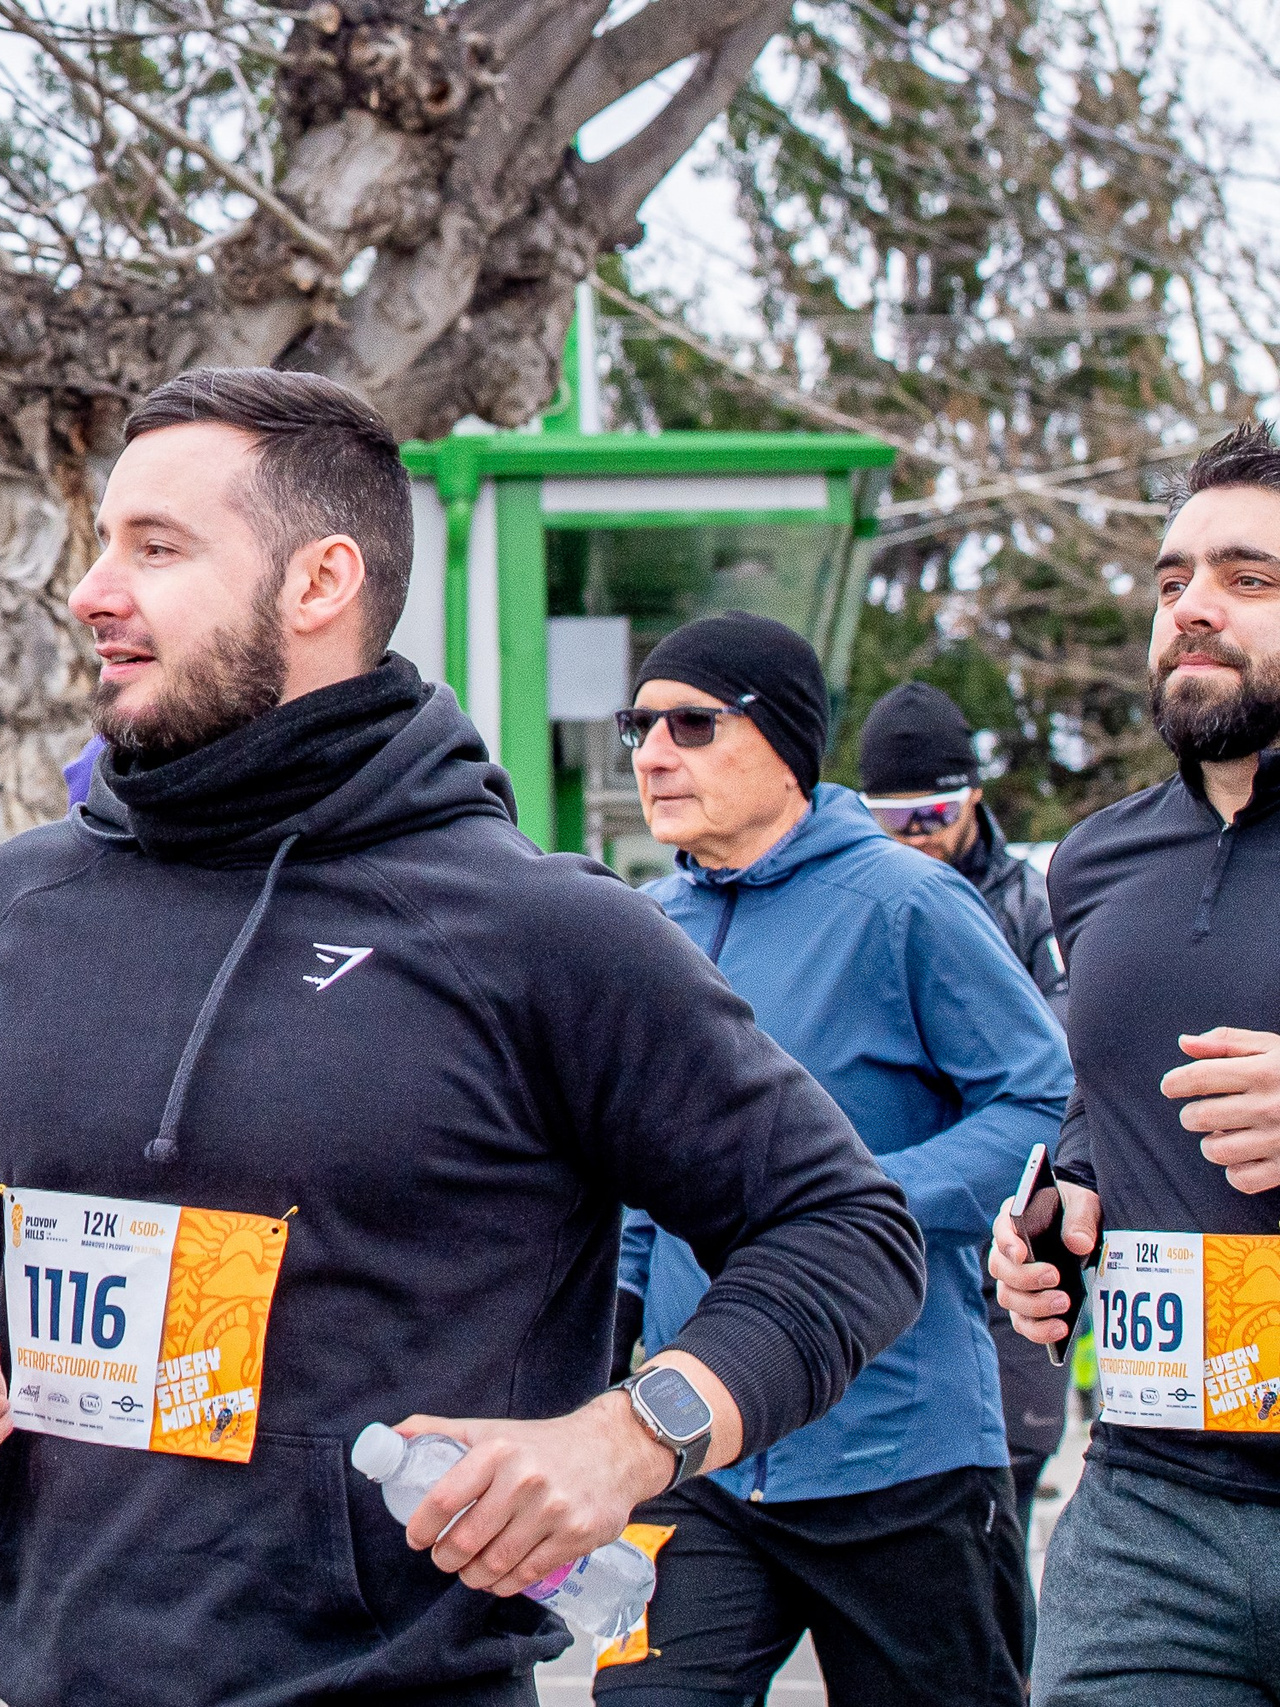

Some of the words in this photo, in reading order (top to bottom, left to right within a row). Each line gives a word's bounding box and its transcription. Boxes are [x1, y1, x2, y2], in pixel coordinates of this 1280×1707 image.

[24, 1228, 45, 1241] HILLS
[25, 1216, 58, 1230] PLOVDIV
[83, 1210, 119, 1238] 12K
[129, 1220, 166, 1238] 450D+
[1136, 1243, 1158, 1264] 12K
[24, 1264, 127, 1350] 1116
[1099, 1289, 1184, 1353] 1369
[102, 1361, 139, 1384] TRAIL
[157, 1347, 220, 1386] EVERY
[1158, 1361, 1189, 1379] TRAIL
[1203, 1343, 1260, 1377] EVERY
[156, 1375, 210, 1410] STEP
[1204, 1367, 1252, 1397] STEP
